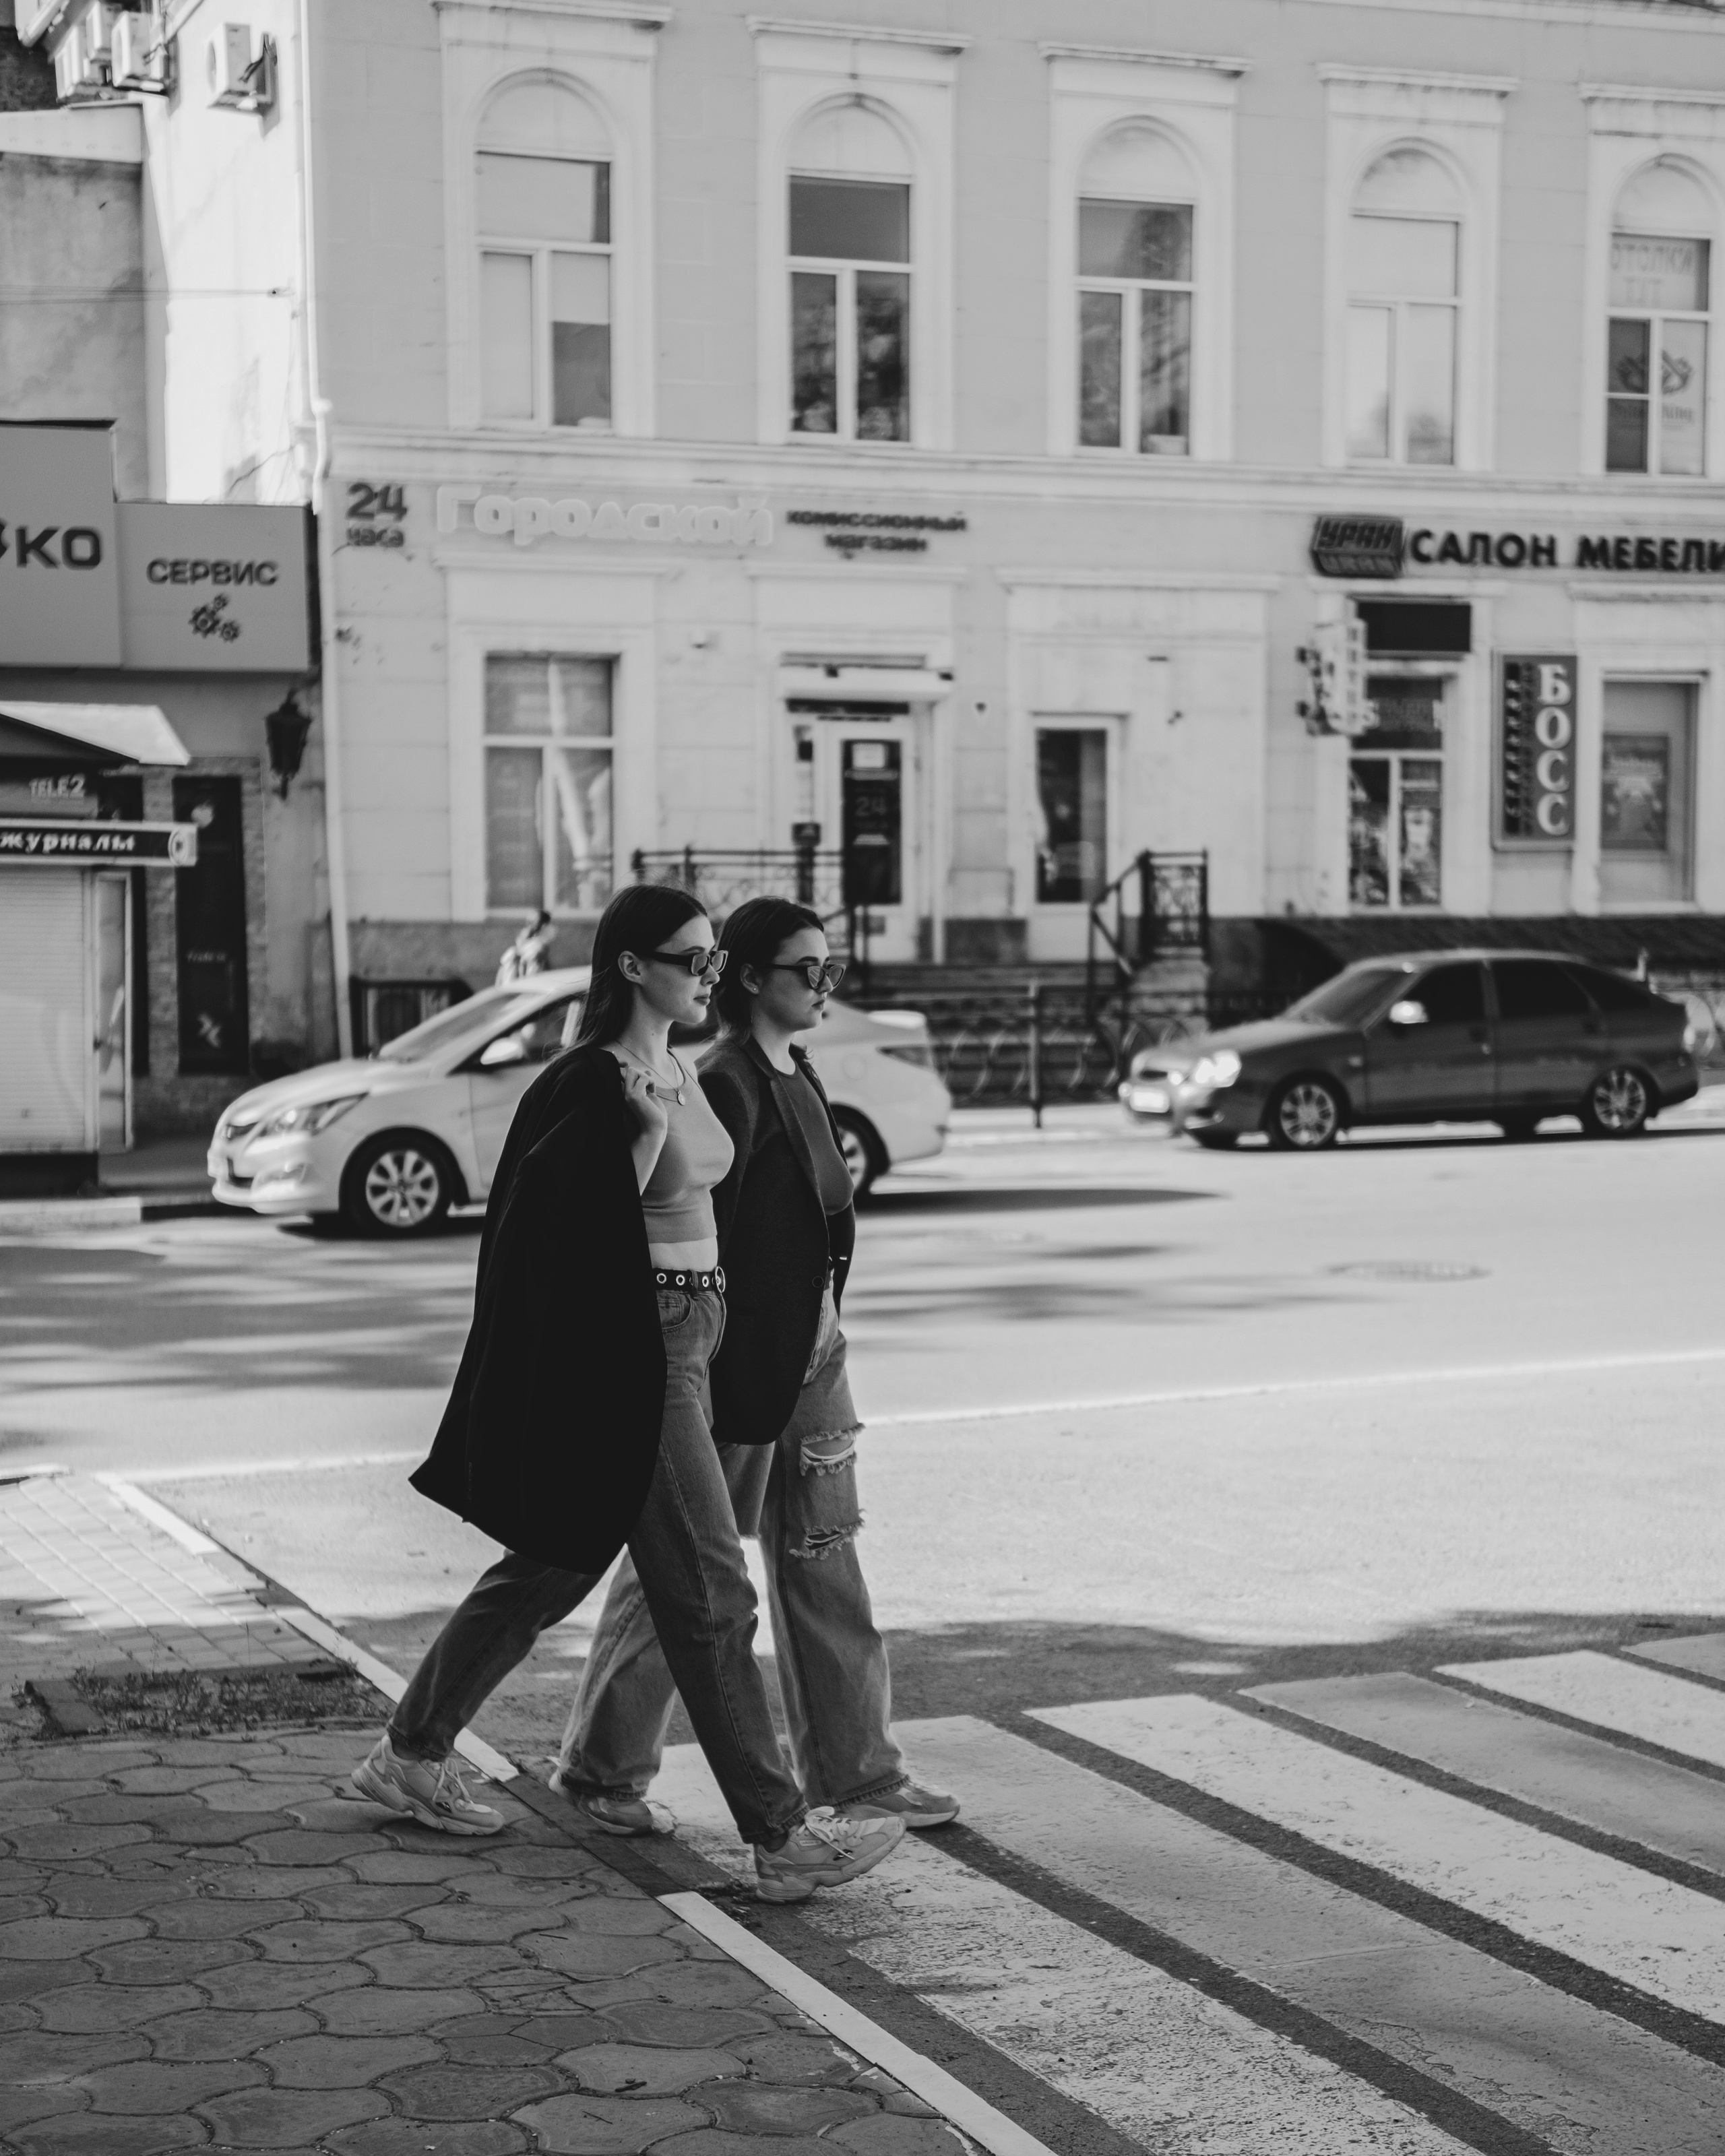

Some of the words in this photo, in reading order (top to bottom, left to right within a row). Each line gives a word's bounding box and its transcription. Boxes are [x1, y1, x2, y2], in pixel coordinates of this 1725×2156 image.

[346, 482, 407, 521] 24
[1410, 530, 1556, 567] САЛОН
[146, 557, 279, 586] СЕРВИС
[1535, 663, 1572, 836] БОСС
[29, 774, 86, 798] TELE2
